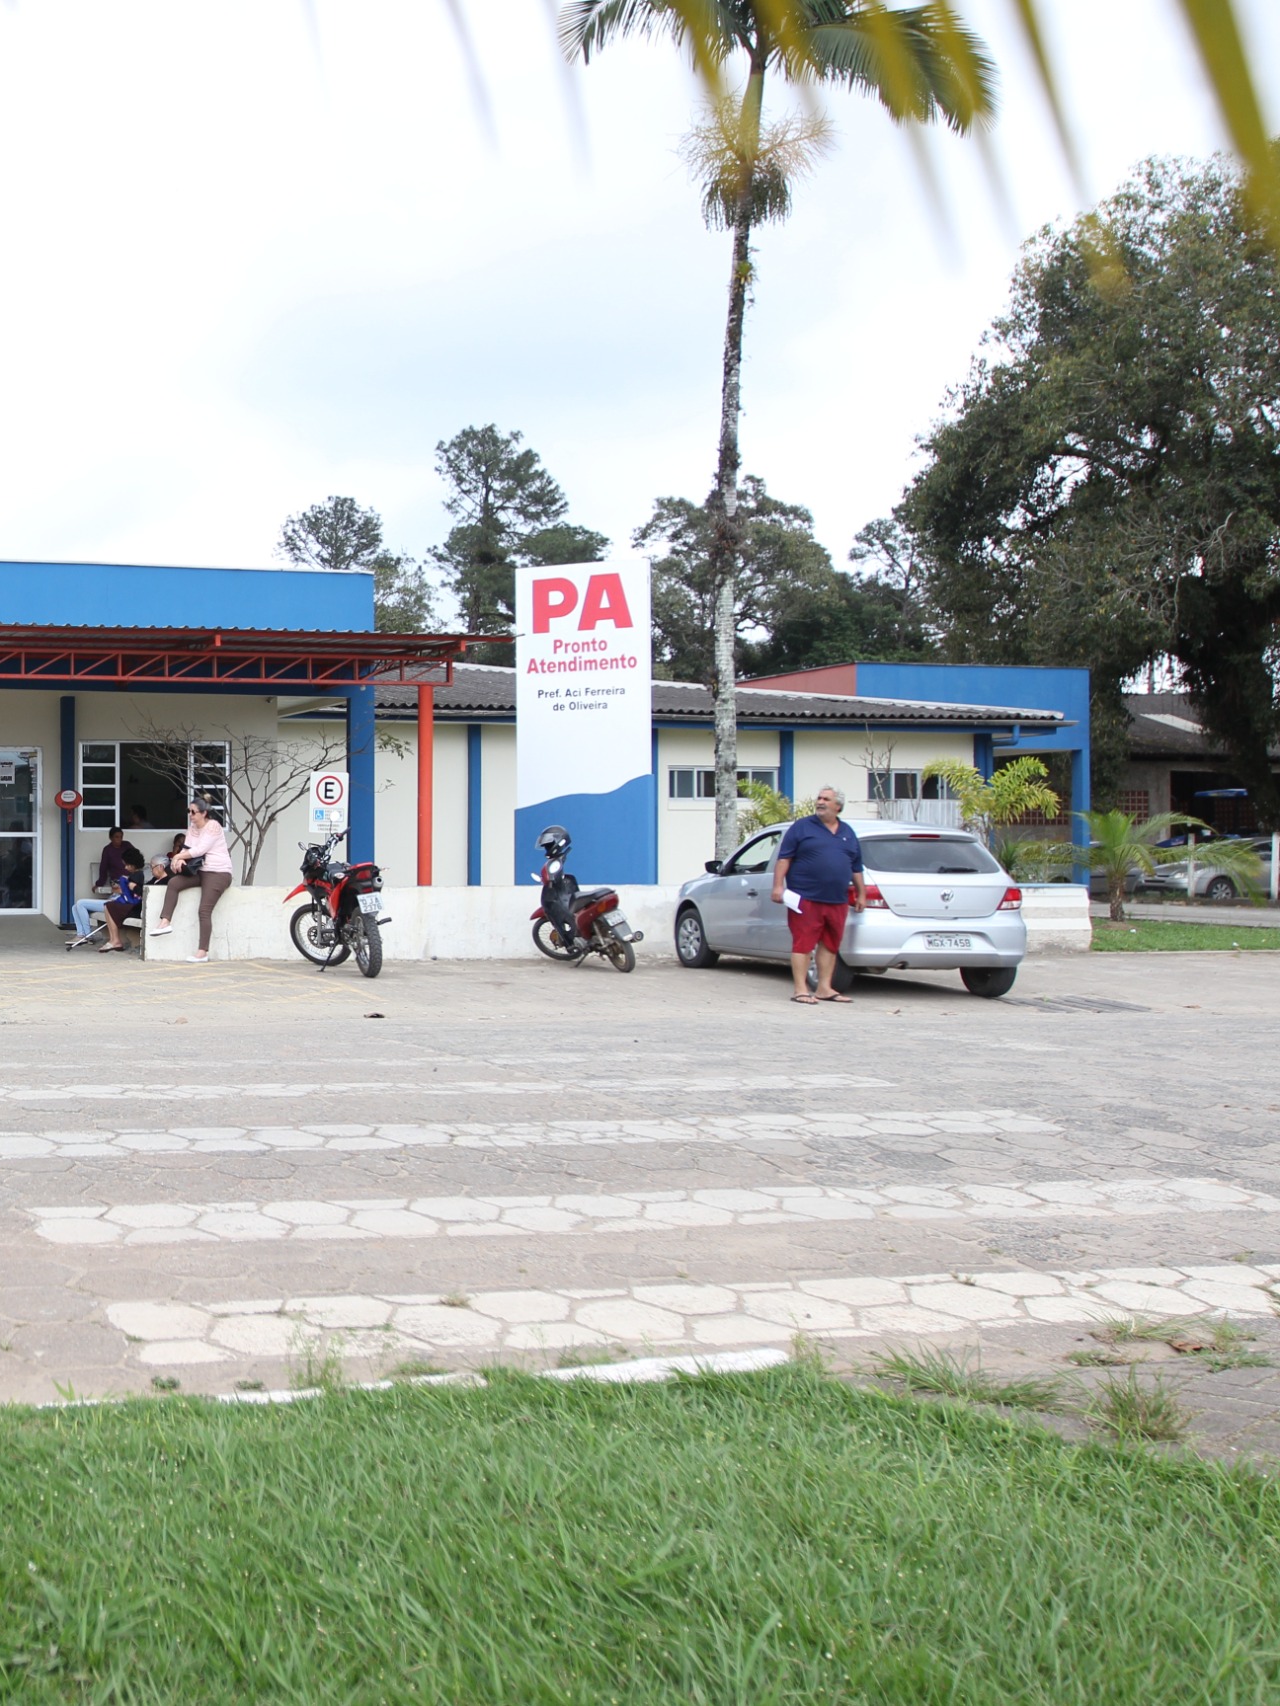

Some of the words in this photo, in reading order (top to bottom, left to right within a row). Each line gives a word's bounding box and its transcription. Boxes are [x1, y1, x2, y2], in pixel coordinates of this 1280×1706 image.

[532, 573, 634, 634] PA
[553, 638, 608, 654] Pronto
[527, 655, 637, 674] Atendimento
[537, 688, 562, 699] Pref.
[565, 687, 582, 698] Aci
[585, 686, 626, 696] Ferreira
[553, 702, 566, 711] de
[568, 700, 608, 711] Oliveira
[324, 782, 335, 800] E
